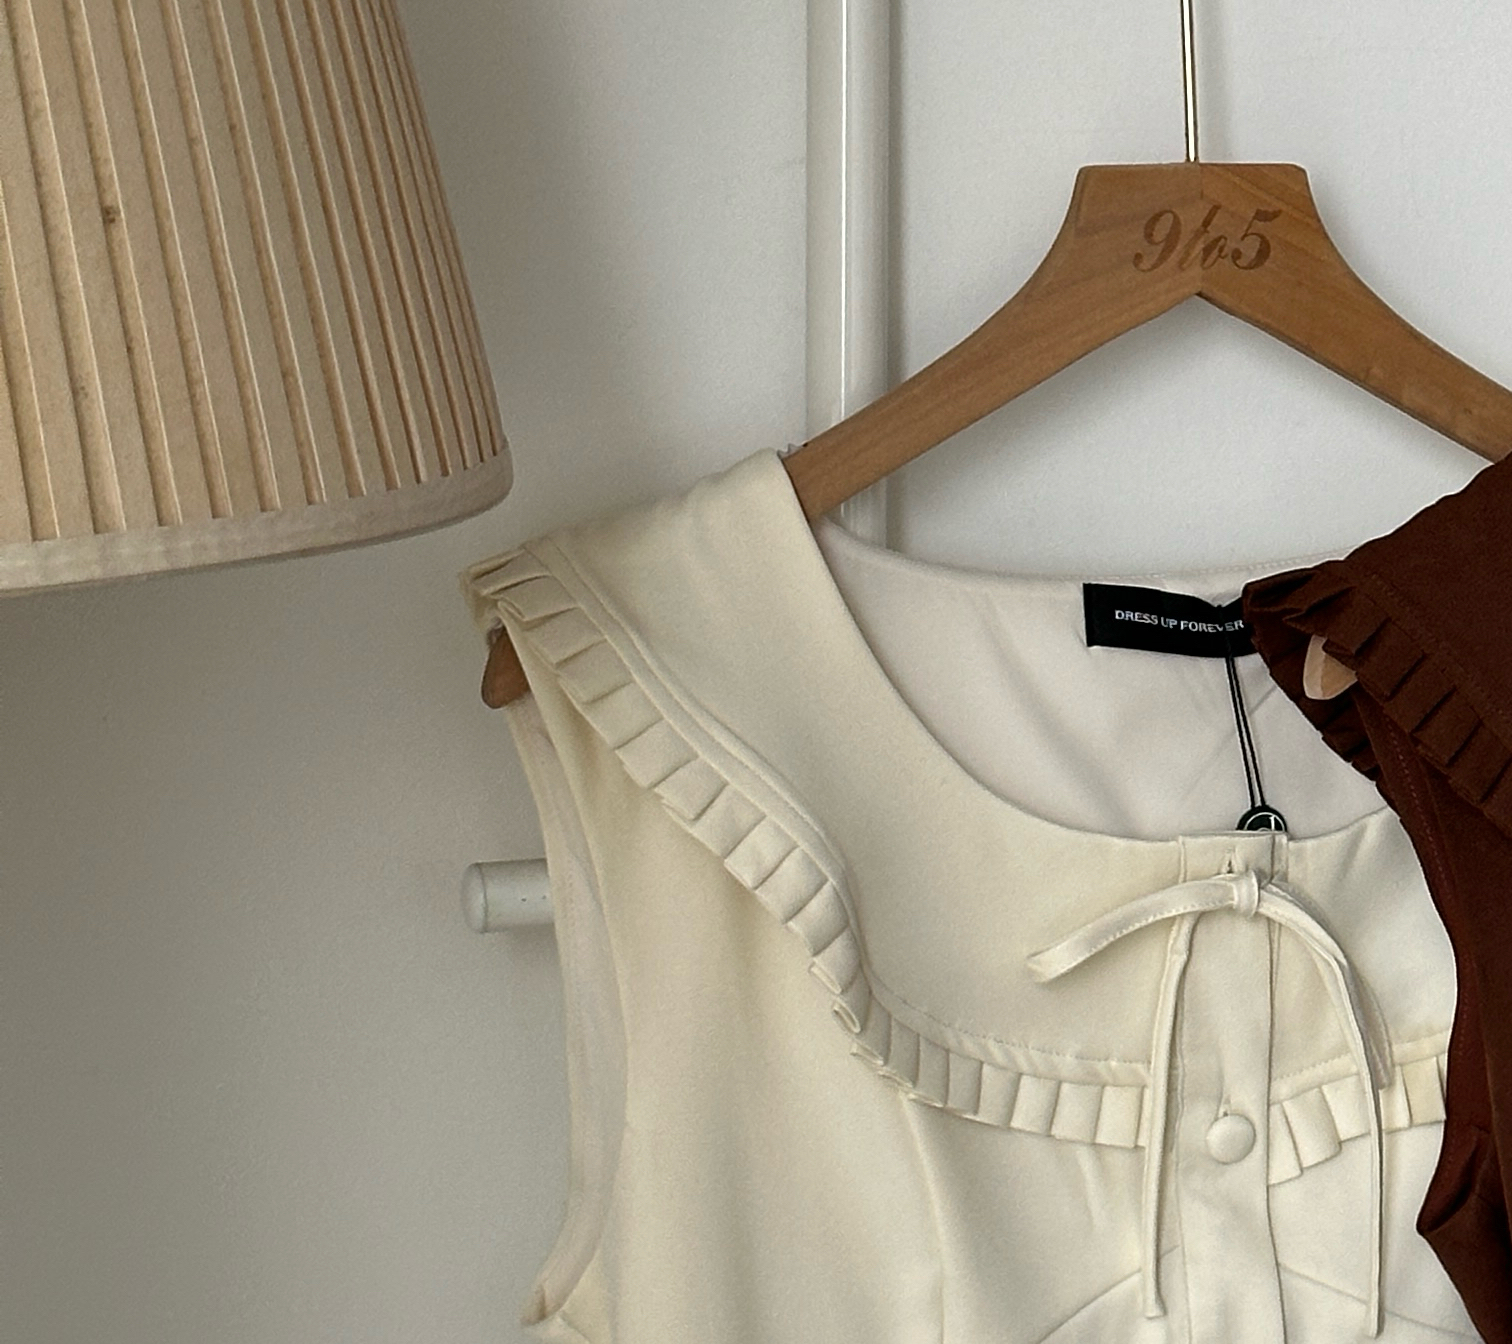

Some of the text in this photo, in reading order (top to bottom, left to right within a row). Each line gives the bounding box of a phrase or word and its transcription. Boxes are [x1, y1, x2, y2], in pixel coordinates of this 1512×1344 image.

[1133, 204, 1282, 272] 9to5
[1114, 609, 1245, 633] DRESS UP FOREVER
